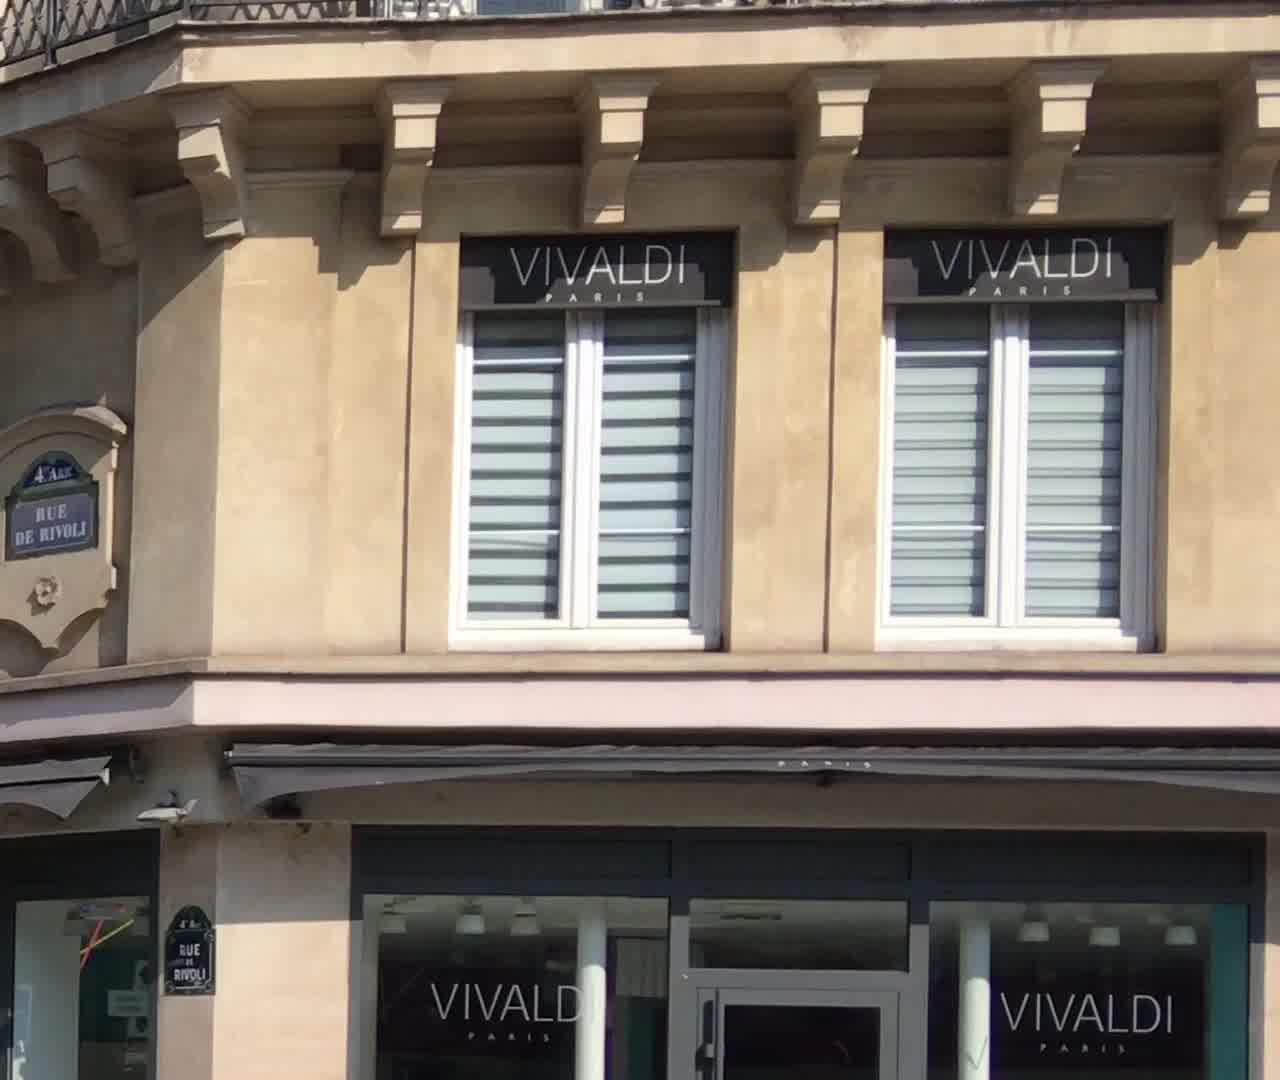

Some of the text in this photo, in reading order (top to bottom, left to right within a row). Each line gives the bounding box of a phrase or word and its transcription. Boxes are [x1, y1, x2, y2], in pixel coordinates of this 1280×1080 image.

[510, 244, 685, 286] VIVALDI
[931, 237, 1112, 280] VIVALDI
[545, 291, 644, 302] PARIS
[968, 286, 1071, 297] PARIS
[35, 503, 68, 522] RUE
[15, 520, 88, 546] DE RIVOLI
[179, 943, 201, 957] RUE
[173, 968, 207, 981] RIVOLI
[430, 983, 586, 1022] VIVALD
[1000, 991, 1173, 1034] VIVALDI
[468, 1031, 550, 1042] PARIS
